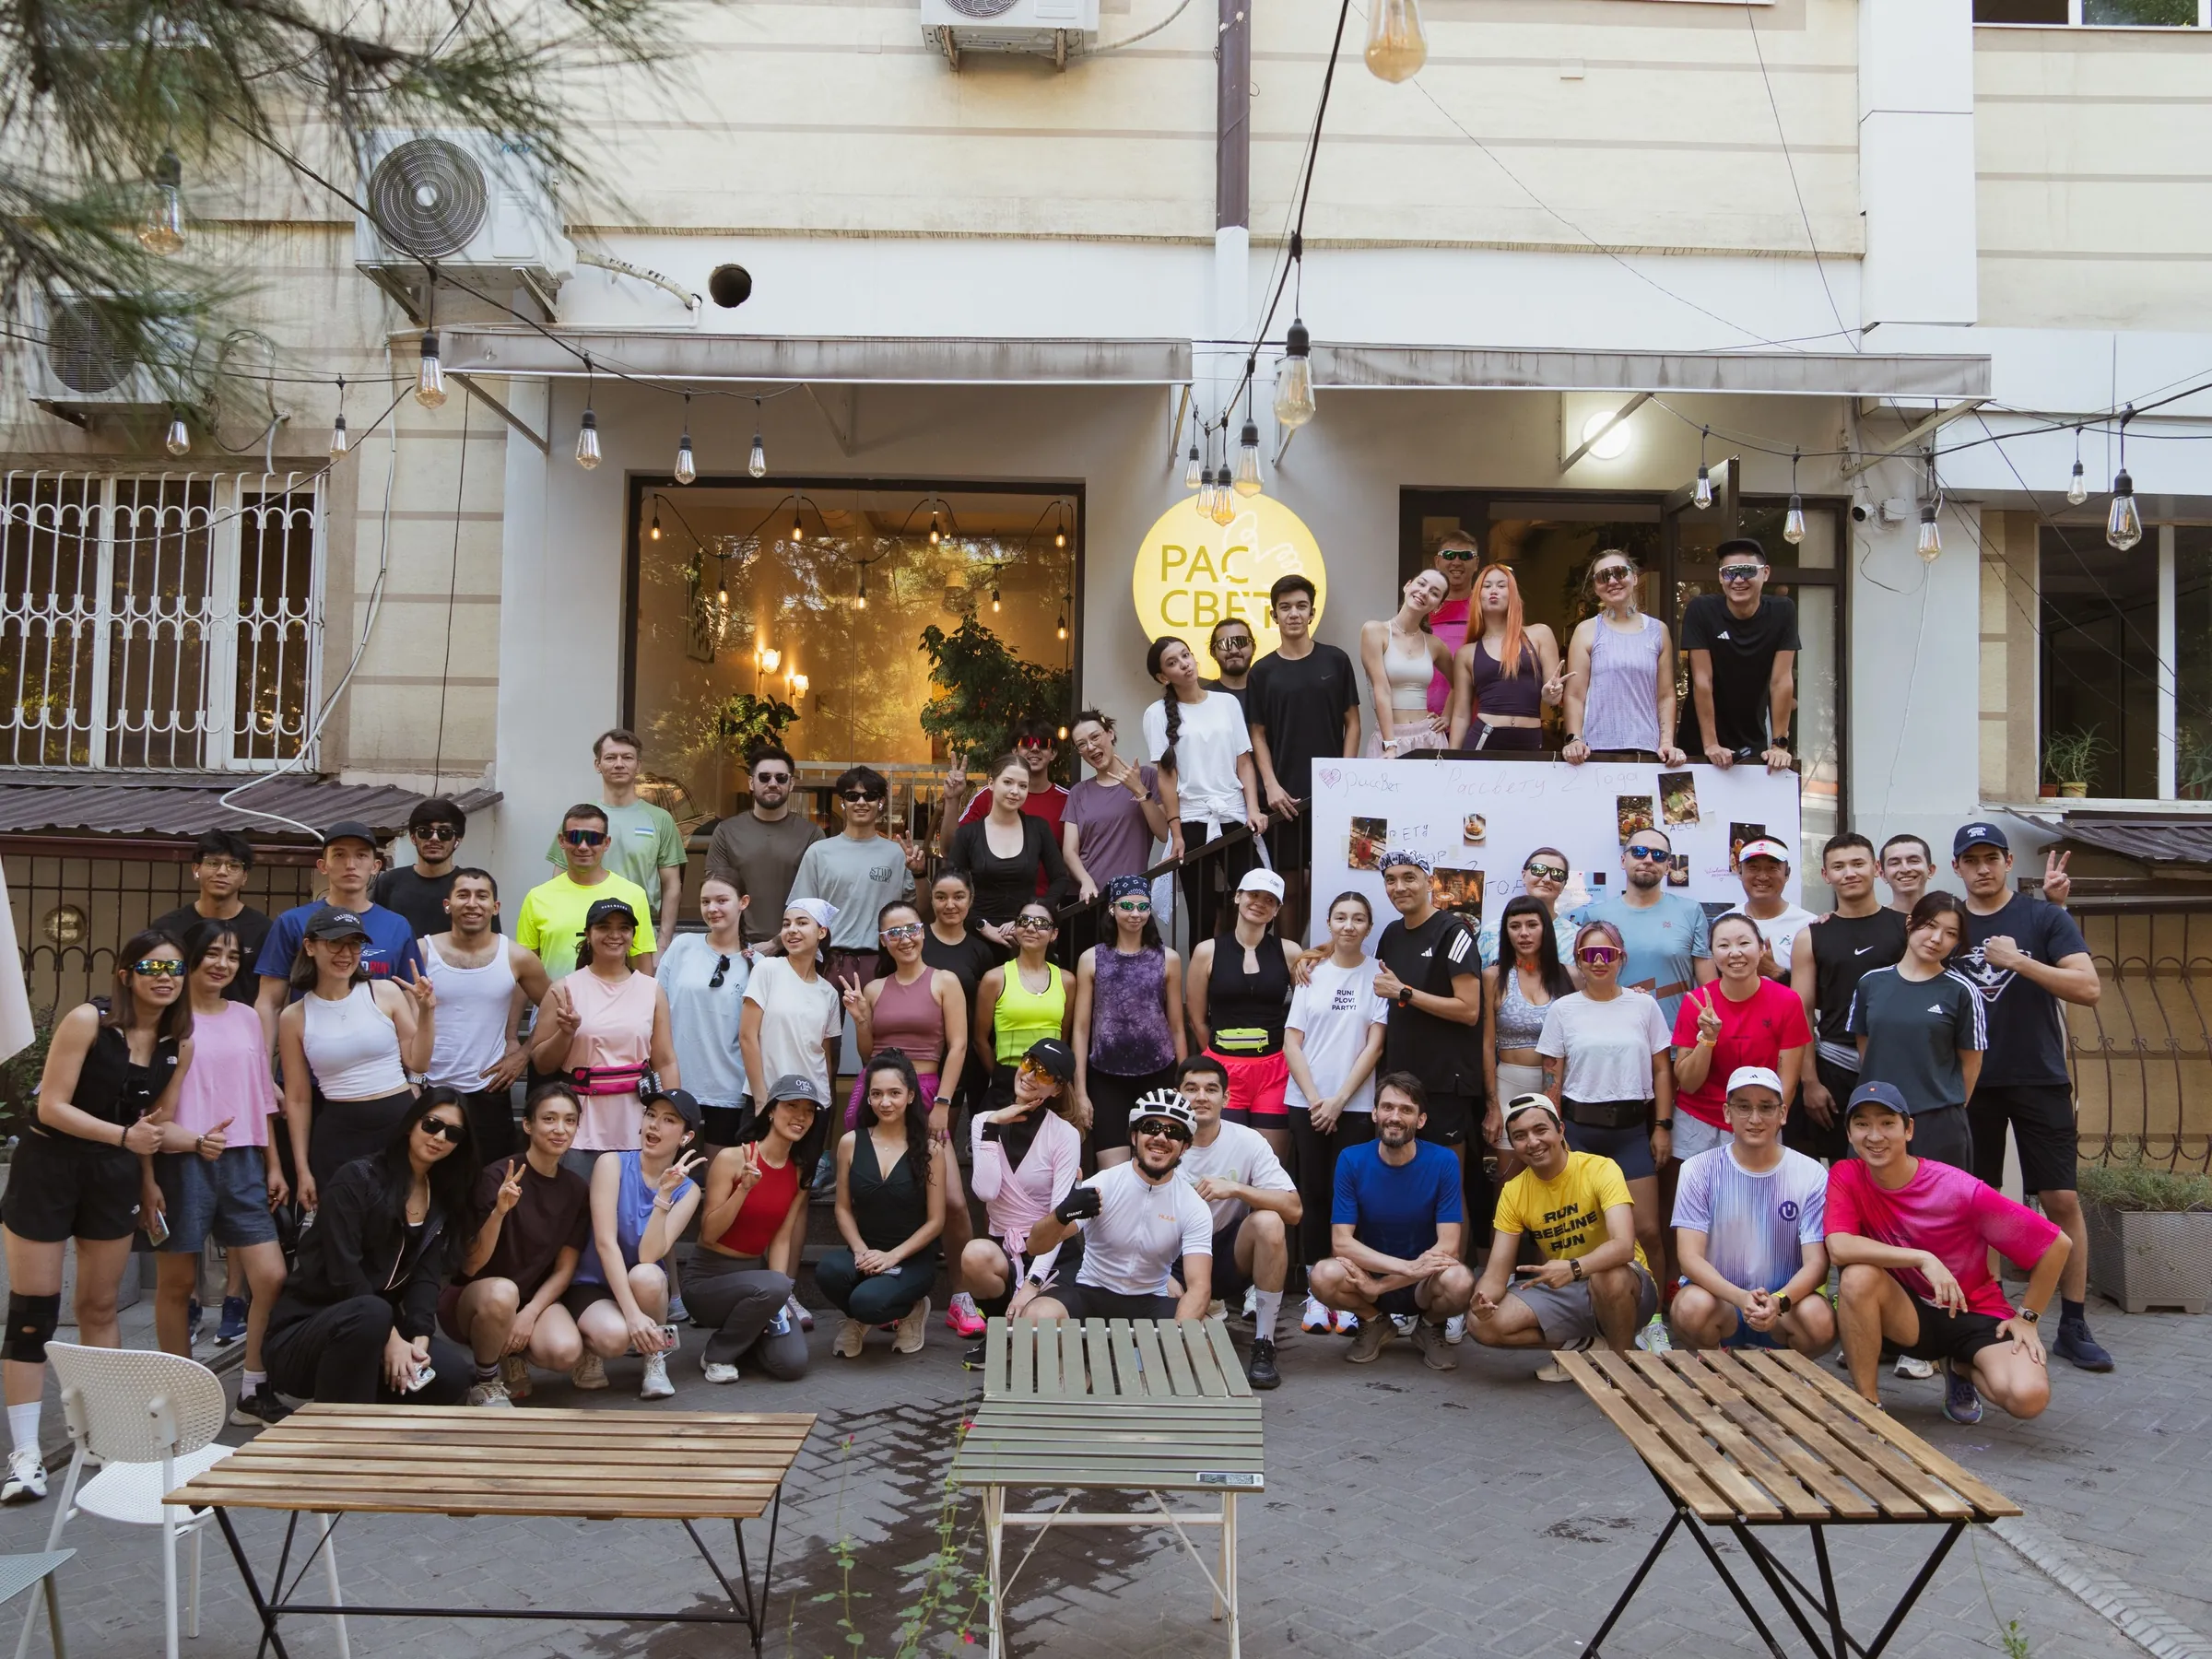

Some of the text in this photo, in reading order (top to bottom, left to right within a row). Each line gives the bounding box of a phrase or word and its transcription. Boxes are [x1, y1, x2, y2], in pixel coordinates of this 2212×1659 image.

[1161, 545, 1249, 583] РАС
[1066, 1209, 1083, 1218] GIANT
[1543, 1202, 1579, 1224] RUN
[1532, 1210, 1598, 1240] BEELINE
[1550, 1232, 1585, 1253] RUN
